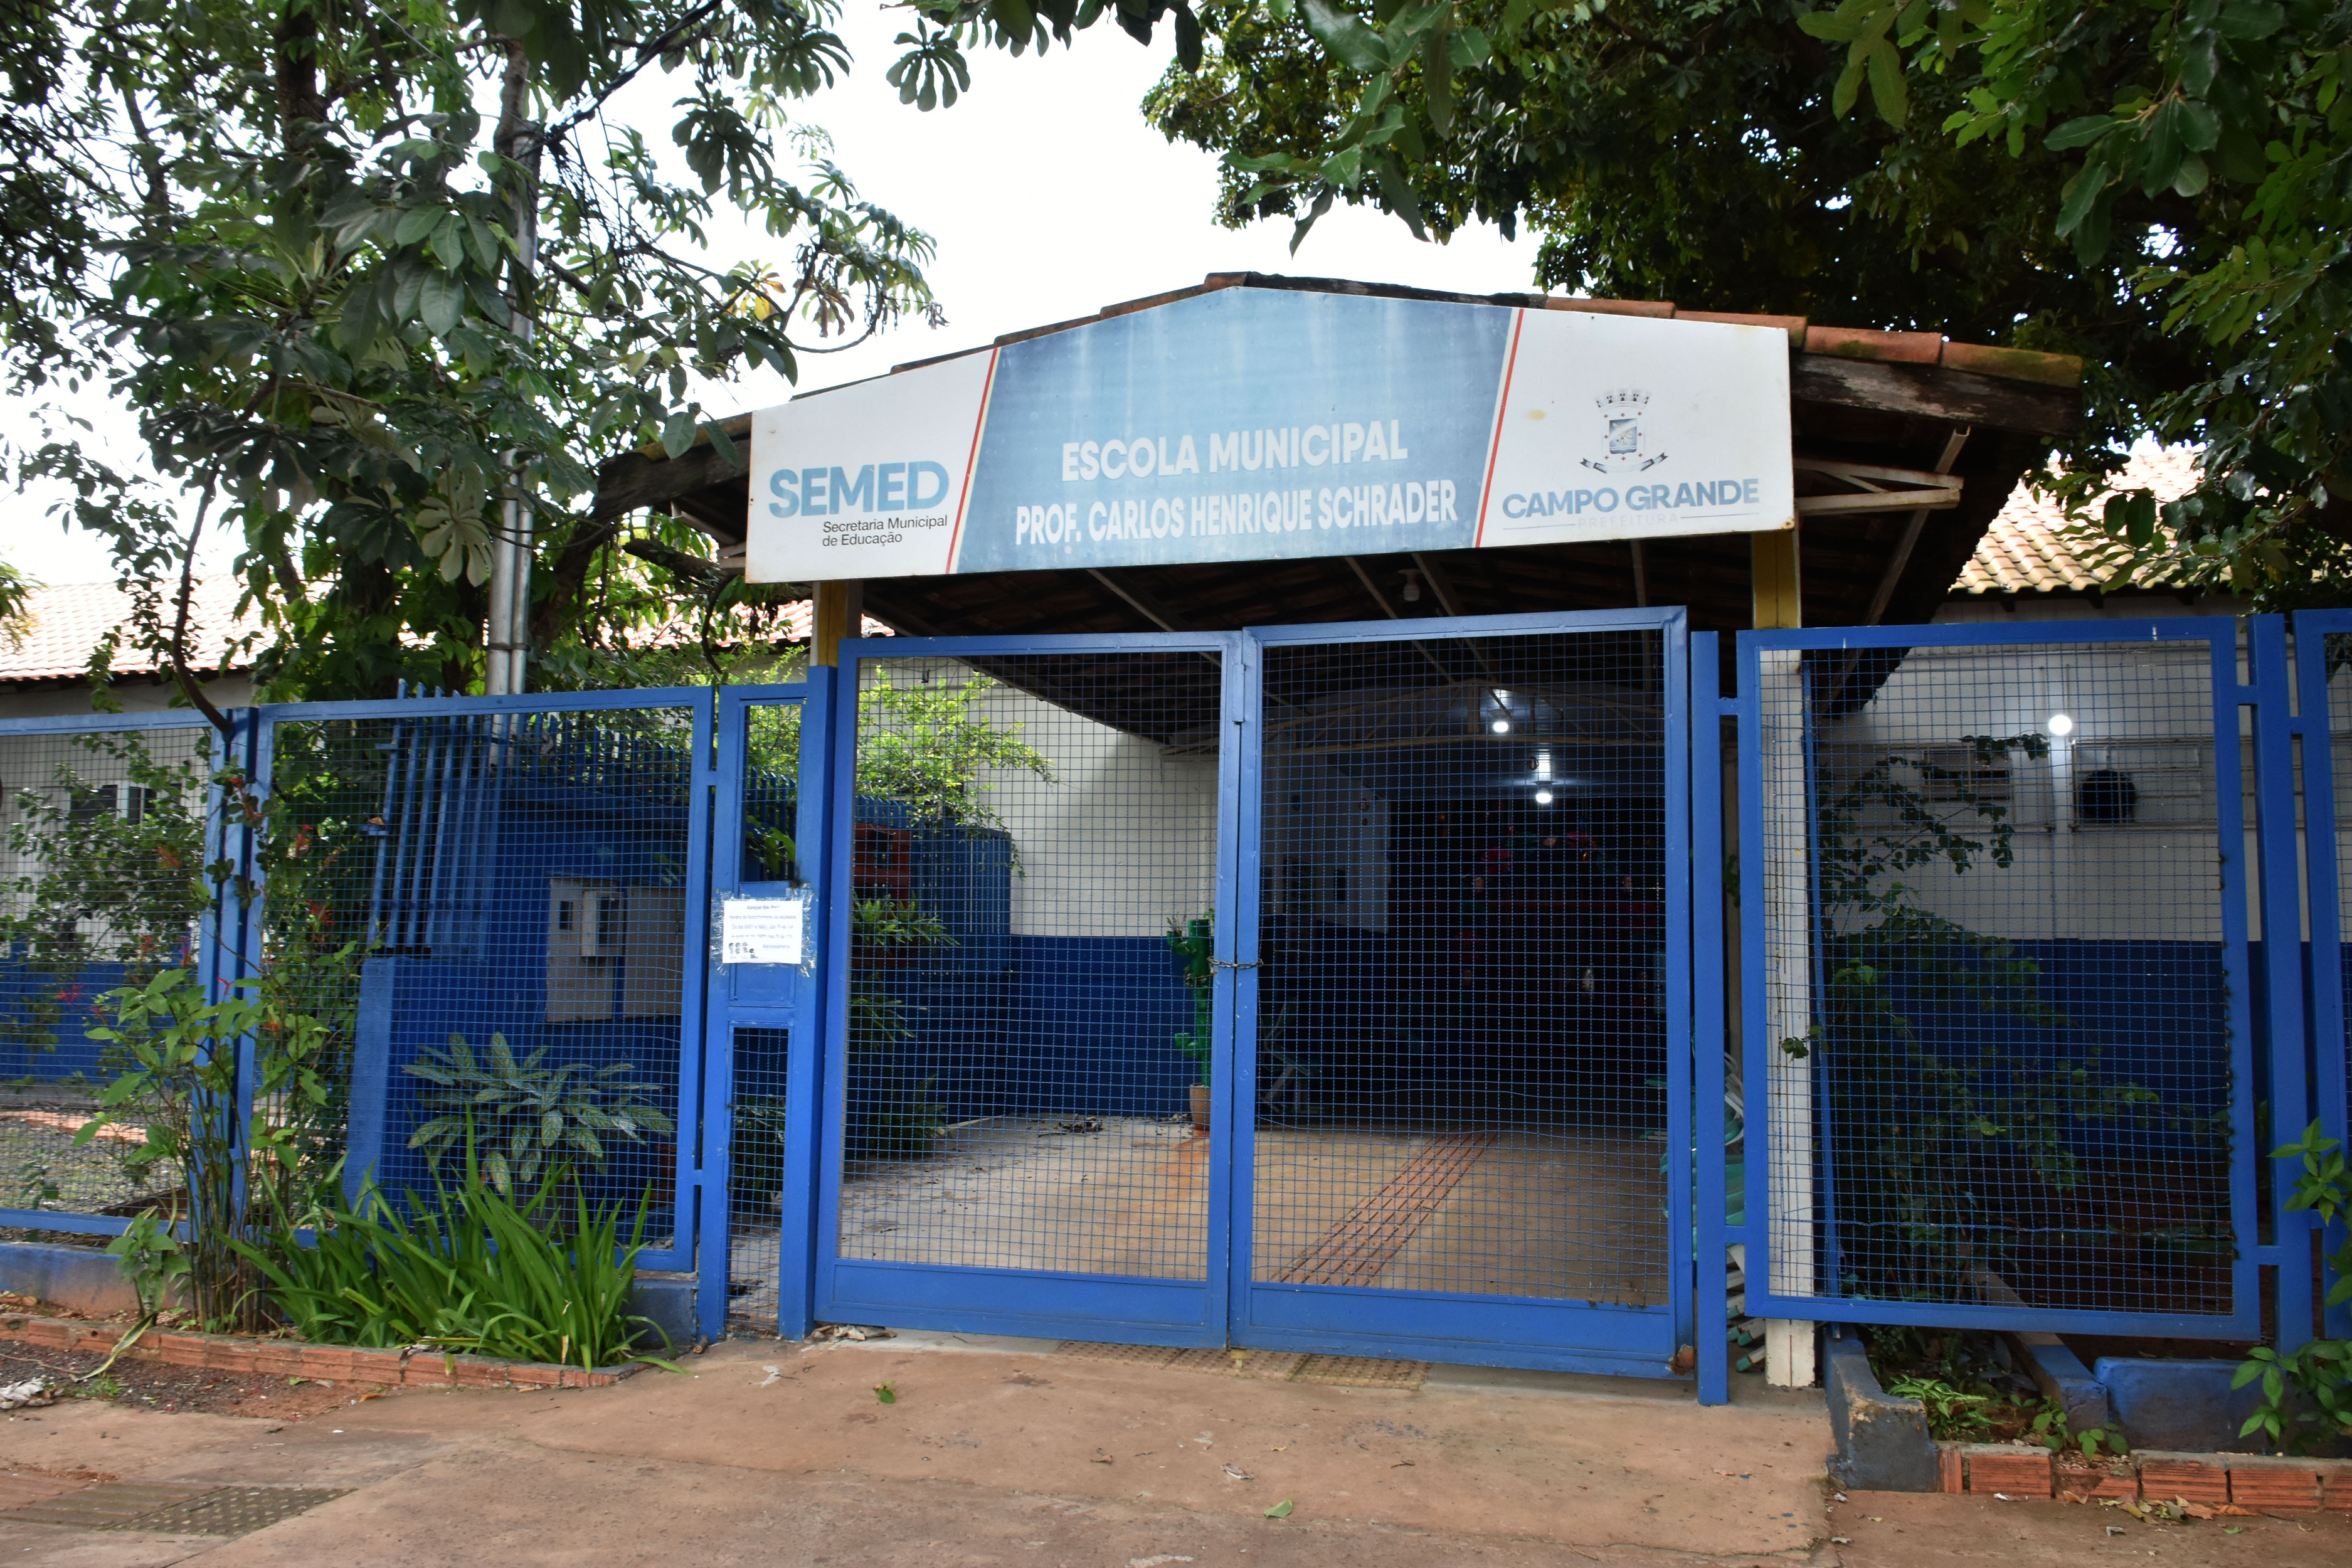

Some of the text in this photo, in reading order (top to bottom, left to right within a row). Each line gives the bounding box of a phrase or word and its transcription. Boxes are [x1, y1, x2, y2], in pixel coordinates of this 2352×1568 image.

[1062, 419, 1408, 482] ESCOLA MUNICIPAL
[768, 460, 950, 519] SEMED
[1502, 478, 1761, 519] CAMPO GRANDE
[823, 515, 948, 533] Secretaria Municipal
[1015, 479, 1458, 546] PROF. CARLOS HENRIQUE SCHRADER
[1578, 513, 1678, 529] PREFEITURA
[822, 531, 903, 547] de Educação
